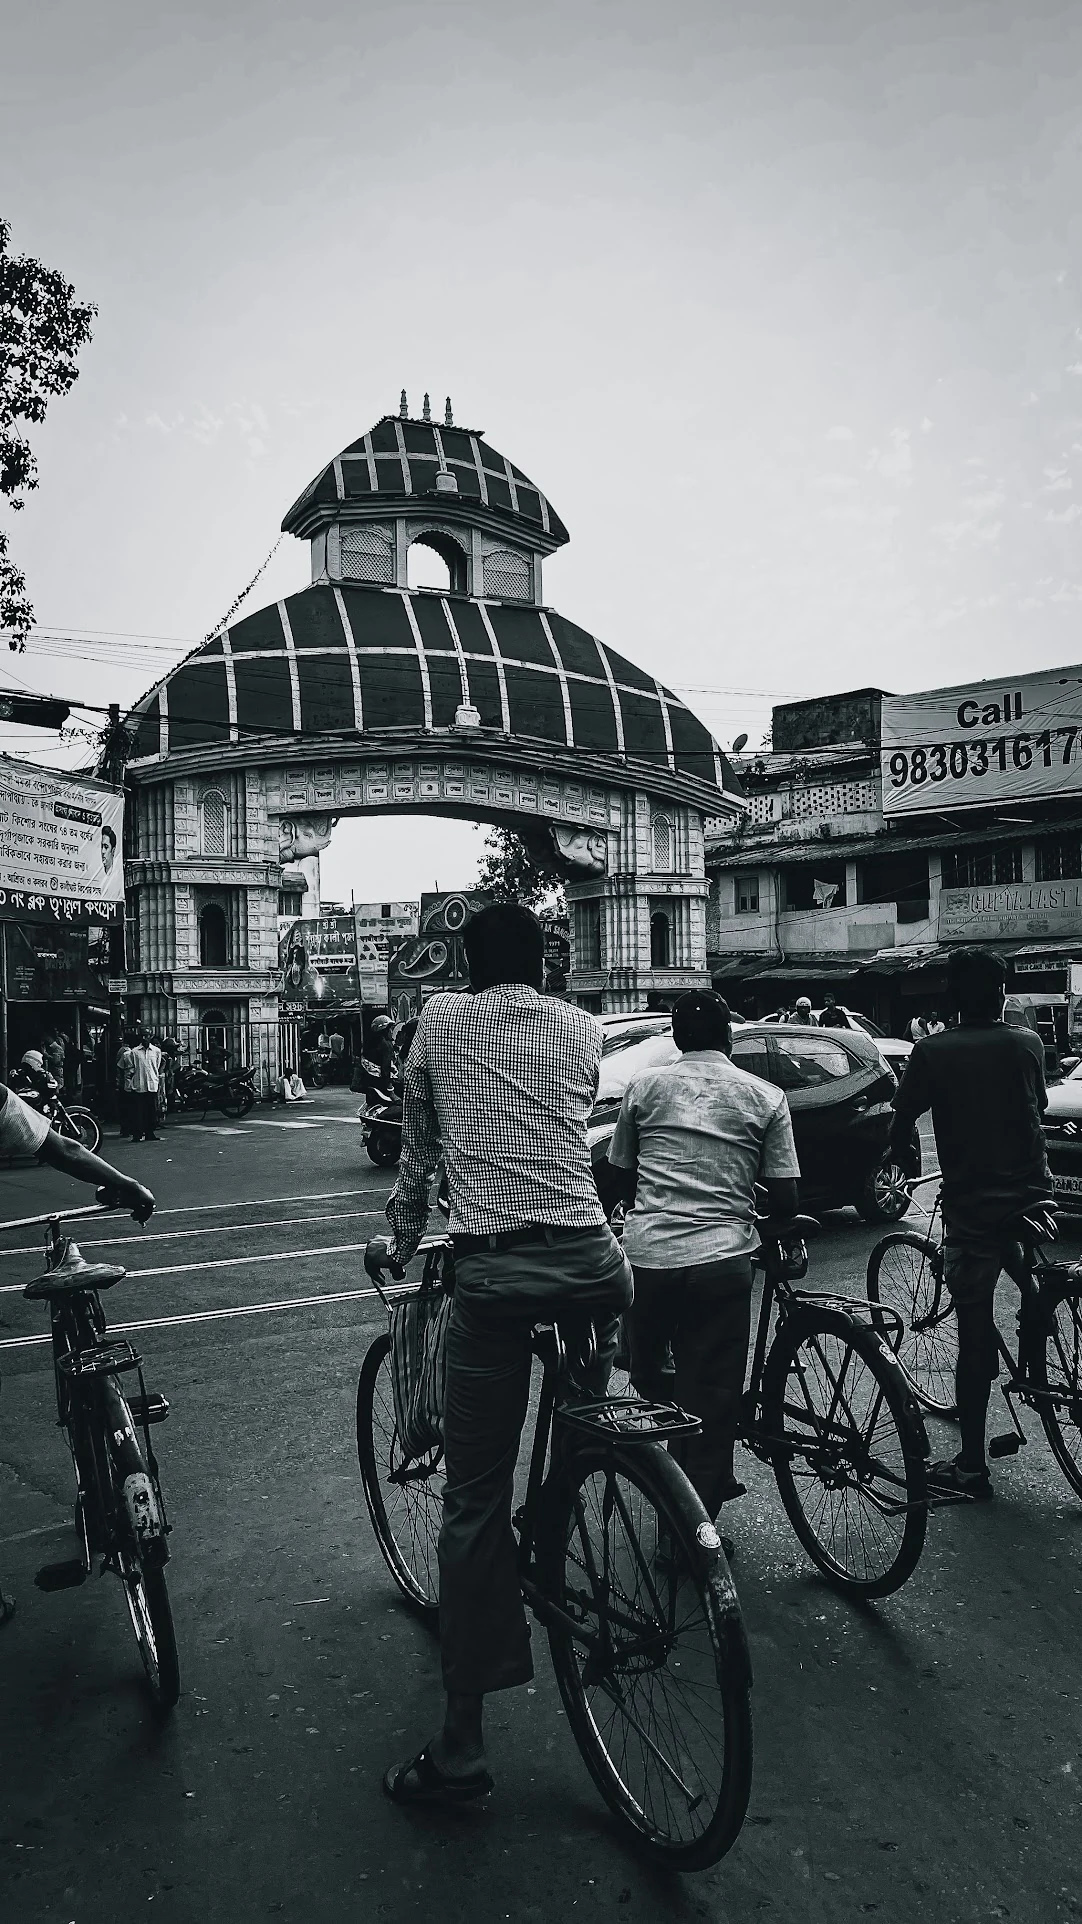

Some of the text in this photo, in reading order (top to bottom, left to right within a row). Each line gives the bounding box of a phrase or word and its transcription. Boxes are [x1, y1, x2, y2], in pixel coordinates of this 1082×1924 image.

[957, 692, 1022, 729] Call
[890, 726, 1082, 788] 983031617
[12, 812, 36, 829] কিশোর
[37, 837, 59, 850] সরকারি
[61, 842, 79, 856] অনুদান
[57, 857, 72, 869] করার
[11, 892, 25, 909] নং
[28, 895, 46, 911] ব্লক
[49, 897, 82, 921] তৃণমূল
[84, 901, 117, 920] কংগ্রেস
[1029, 887, 1069, 910] FAST
[323, 929, 341, 943] কালী
[342, 932, 356, 946] পূজা
